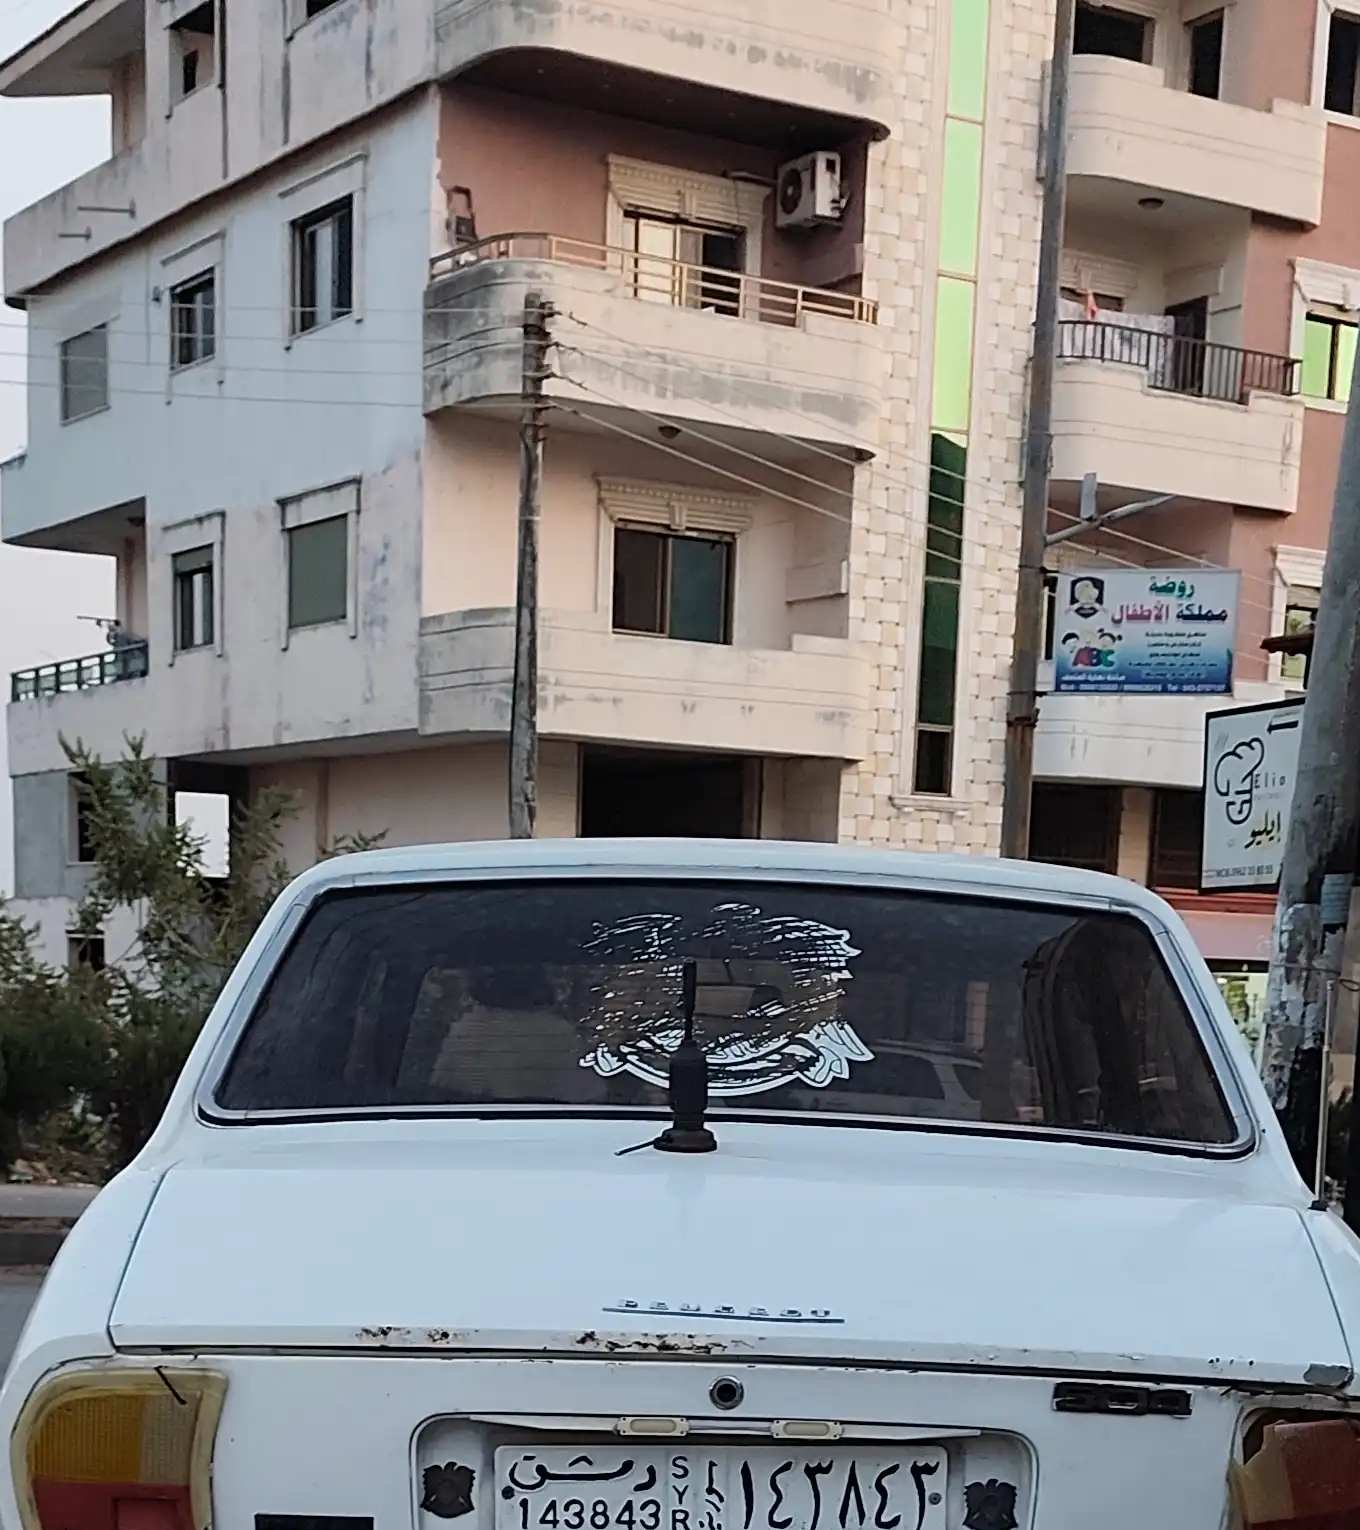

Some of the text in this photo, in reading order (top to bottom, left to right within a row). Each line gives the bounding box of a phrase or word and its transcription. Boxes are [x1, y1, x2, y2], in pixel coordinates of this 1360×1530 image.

[1149, 576, 1195, 598] روضة
[1111, 600, 1228, 624] مملكة الأطفال
[1072, 647, 1115, 667] ABC
[1254, 772, 1286, 789] Elio
[1244, 809, 1281, 849] إيليو
